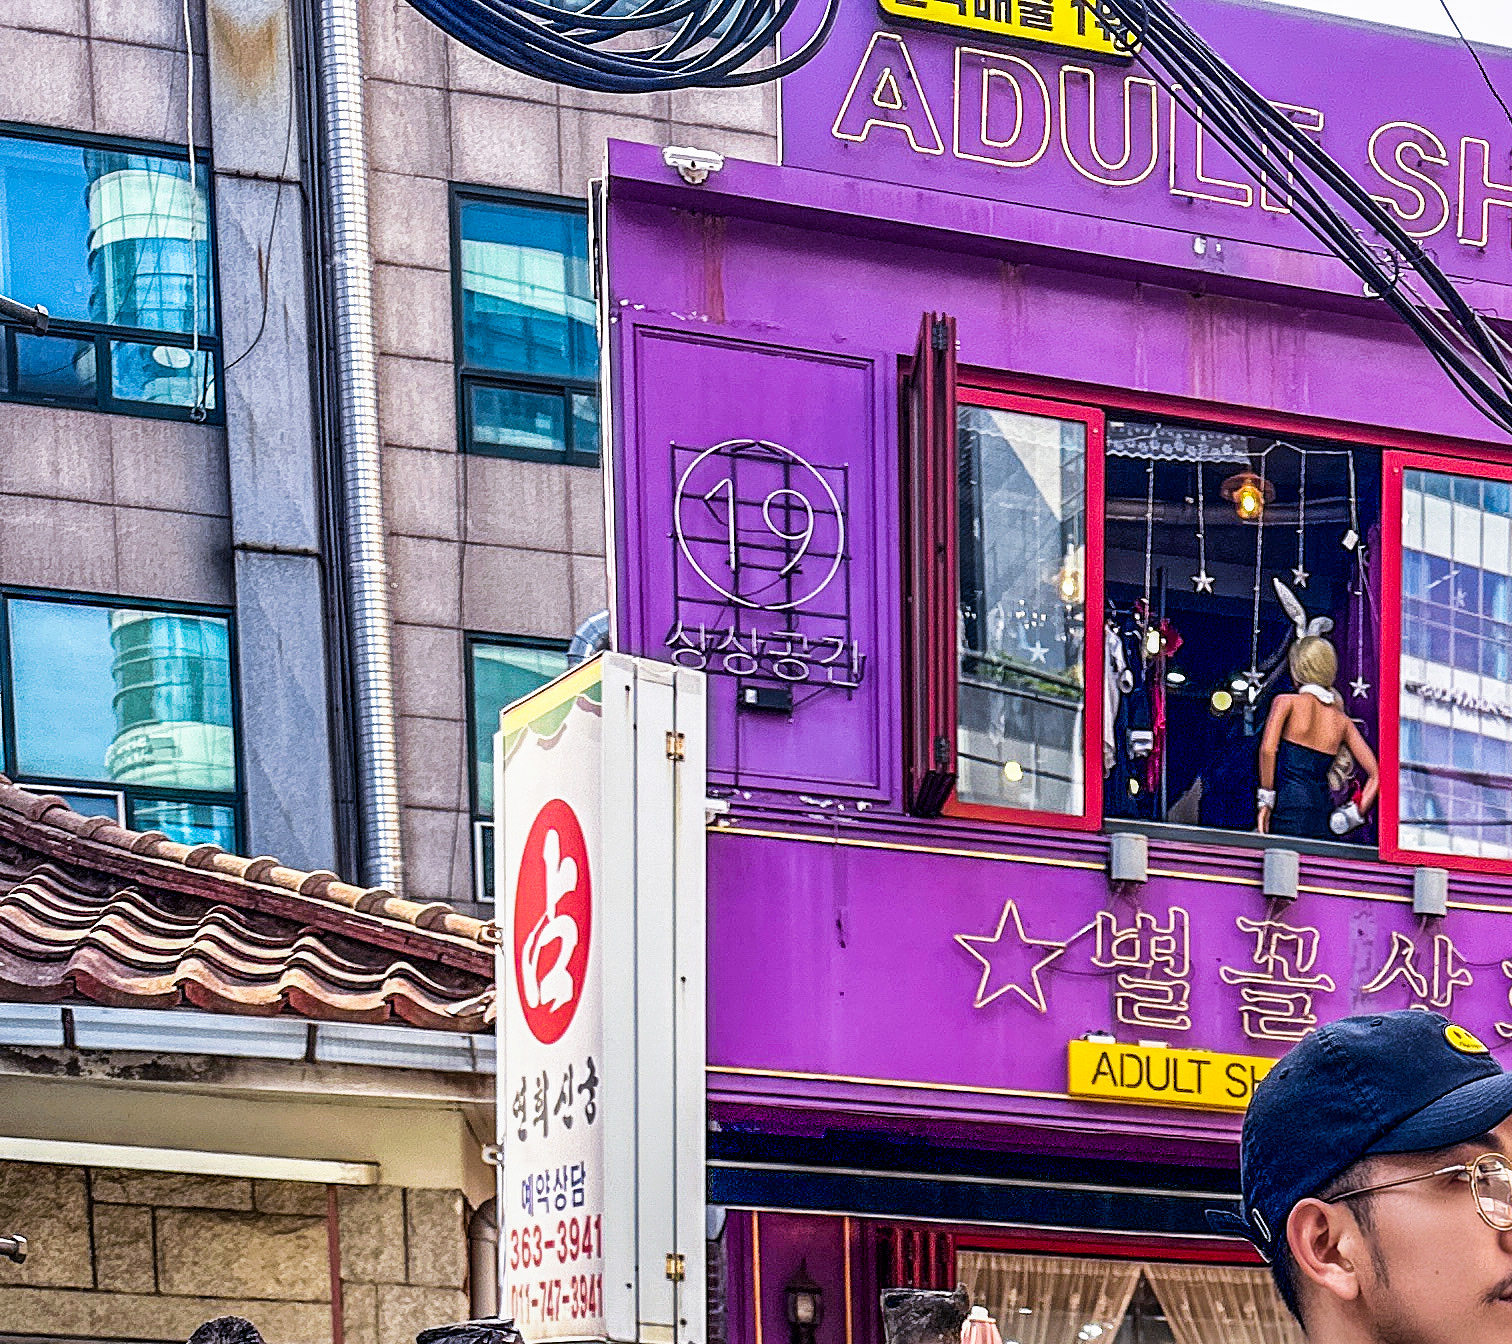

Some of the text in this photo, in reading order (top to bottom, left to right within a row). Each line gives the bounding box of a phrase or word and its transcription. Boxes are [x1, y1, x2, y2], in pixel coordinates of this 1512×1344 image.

[833, 31, 1324, 214] ADULT
[703, 477, 814, 577] 19
[665, 619, 862, 688] 상상공간
[1091, 1051, 1212, 1095] ADULT
[521, 1161, 586, 1217] 예약상담
[510, 1213, 602, 1271] 363-3941
[511, 1273, 604, 1324] 011-747-3941
